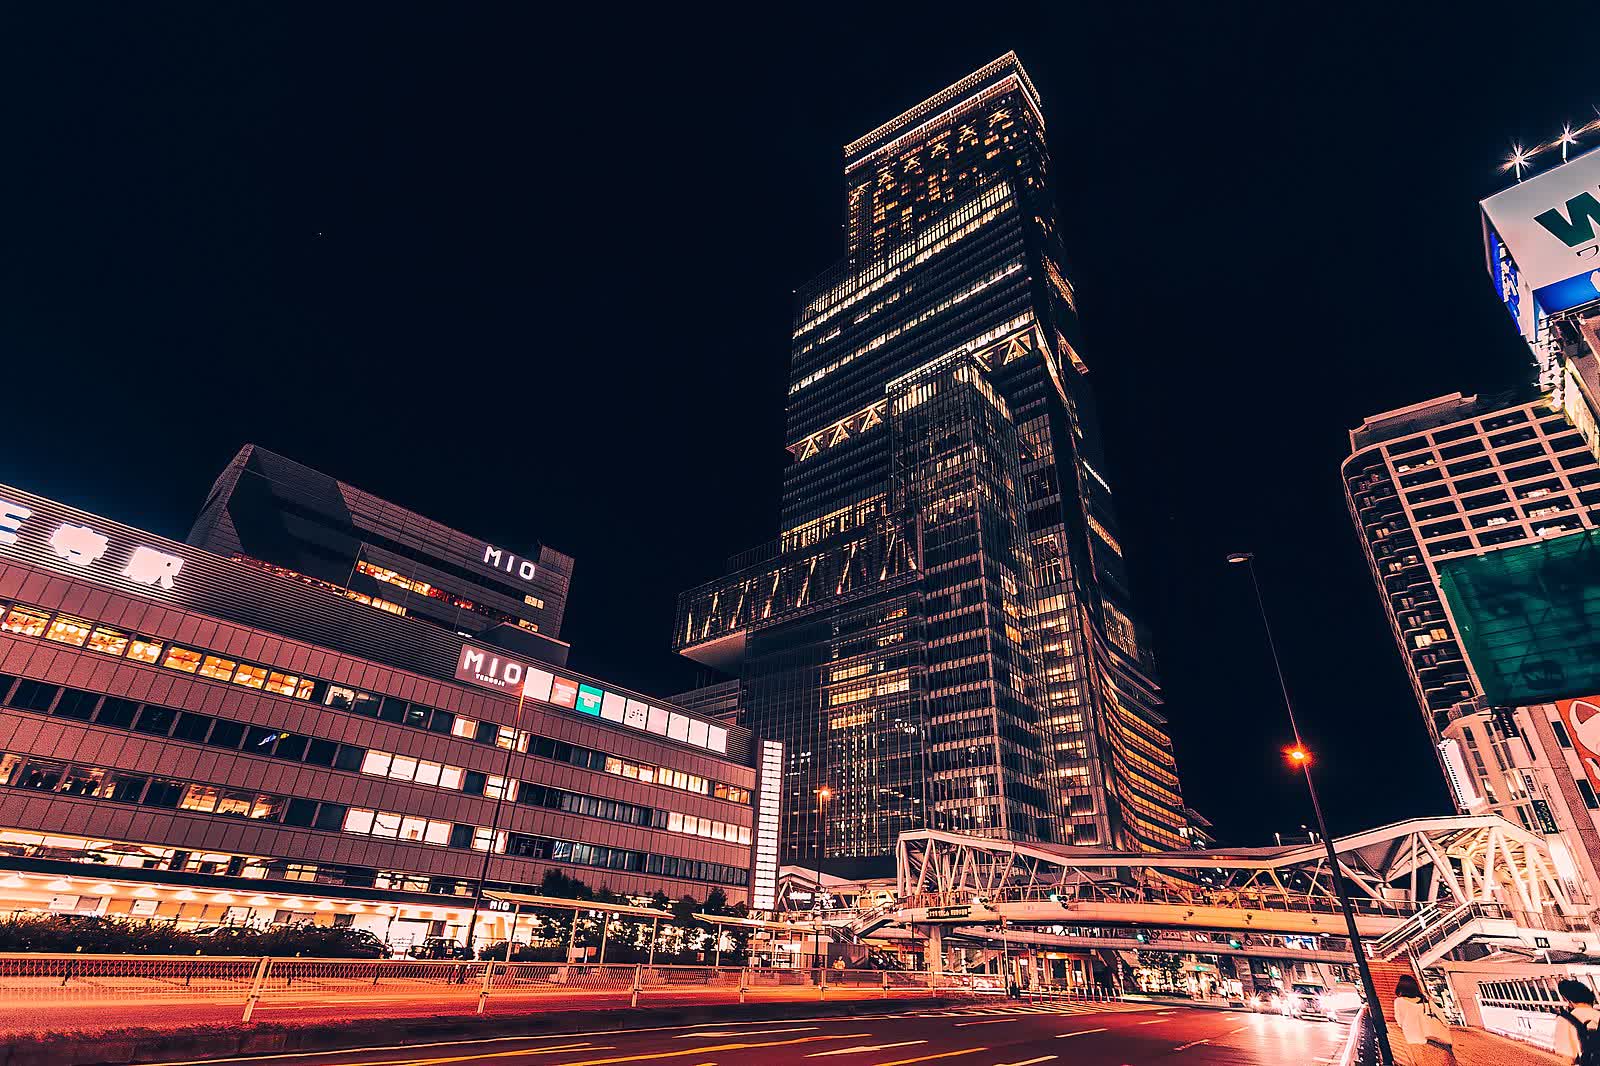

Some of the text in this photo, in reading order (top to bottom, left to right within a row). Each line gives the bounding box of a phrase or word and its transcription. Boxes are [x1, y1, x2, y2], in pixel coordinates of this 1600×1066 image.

[483, 545, 536, 580] MIO
[463, 650, 522, 684] MIO
[489, 900, 511, 911] MIO
